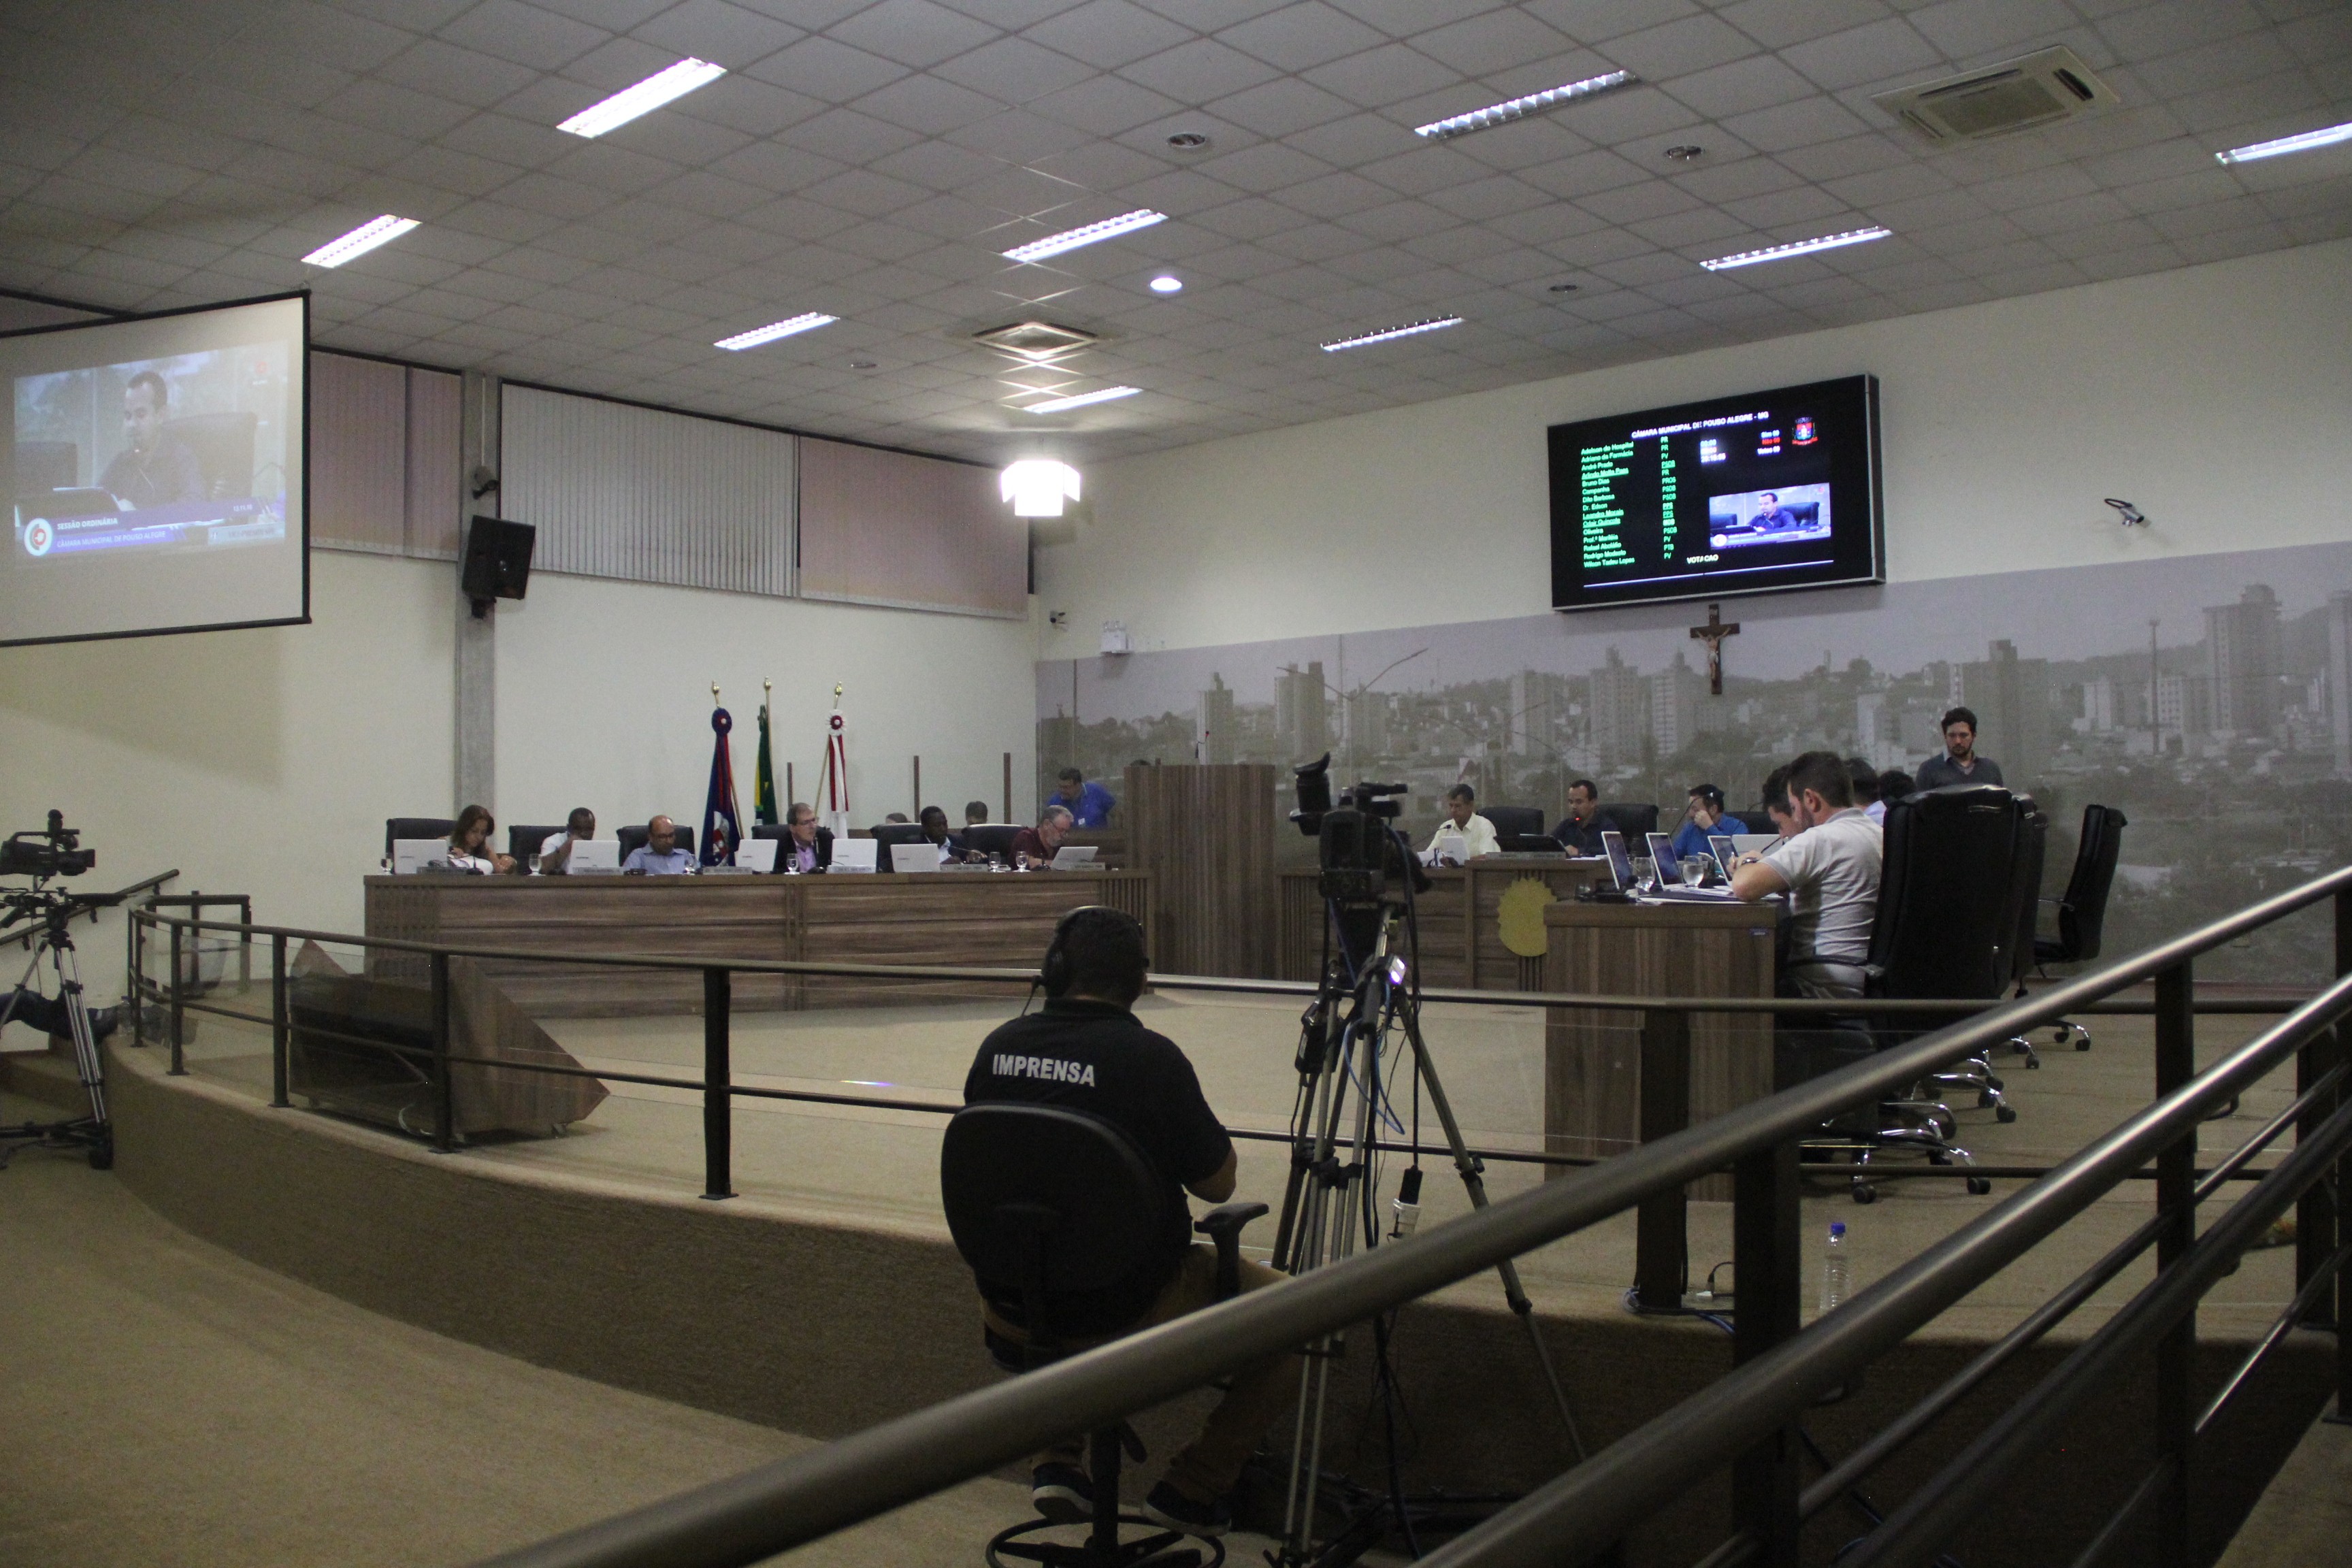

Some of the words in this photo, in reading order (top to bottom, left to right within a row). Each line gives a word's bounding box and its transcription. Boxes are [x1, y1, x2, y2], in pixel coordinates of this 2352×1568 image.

[1631, 428, 1658, 438] CÂMARA
[1659, 423, 1692, 434] MUNICIPAL
[1703, 417, 1726, 427] POUSO
[1727, 413, 1753, 424] ALEGRE
[1757, 411, 1769, 419] MG
[1661, 459, 1676, 469] PSDB
[1662, 476, 1676, 485] PROS
[1662, 485, 1676, 493] PSDB
[56, 519, 81, 530] SESSÃO
[82, 517, 118, 528] ORDINÁRIA
[56, 538, 81, 548] CÂMARA
[82, 536, 113, 546] MUNICIPAL
[122, 533, 144, 542] POUSO
[144, 530, 166, 539] ALEGRE
[992, 1054, 1095, 1087] IMPRENSA
